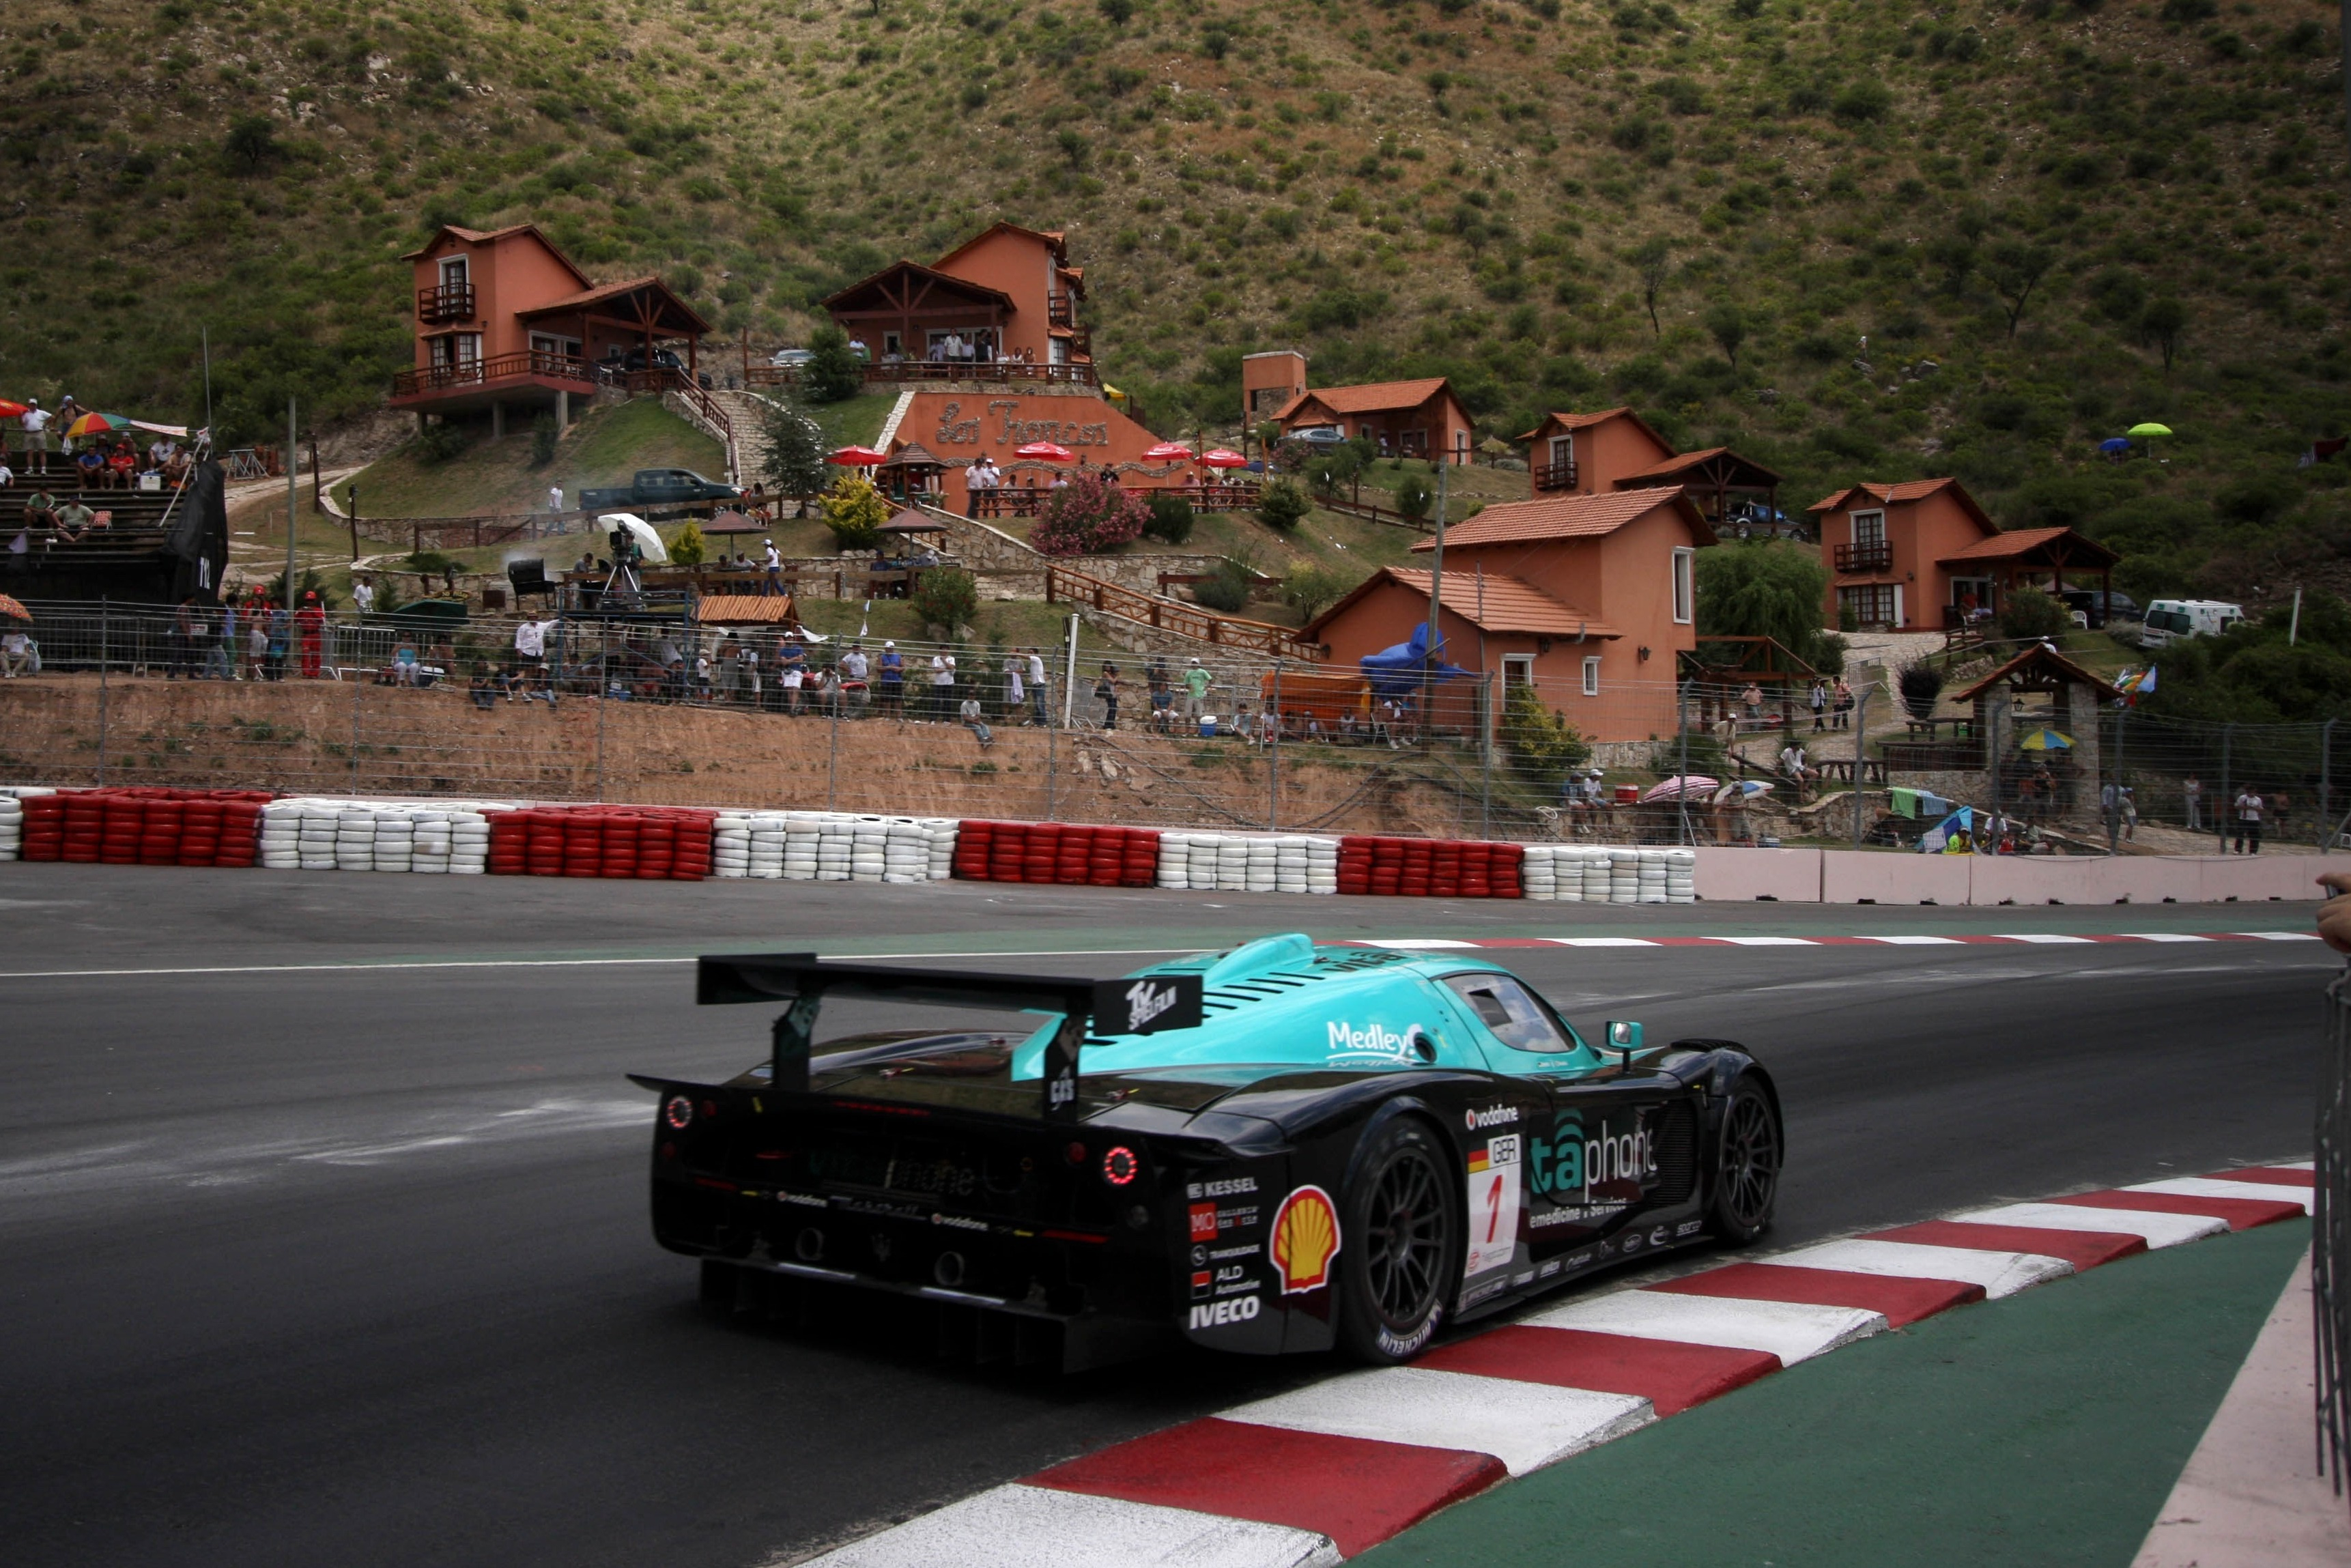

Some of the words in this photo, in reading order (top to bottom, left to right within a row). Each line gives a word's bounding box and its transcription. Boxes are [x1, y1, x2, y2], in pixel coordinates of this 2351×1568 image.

[1327, 1021, 1408, 1061] Medley
[1475, 1103, 1519, 1128] vodafone
[1493, 1138, 1516, 1164] GER
[1204, 1177, 1259, 1197] KESSEL
[1487, 1174, 1502, 1244] 1
[1215, 1265, 1244, 1282] ALD
[1189, 1296, 1260, 1330] IVECO
[1378, 1320, 1431, 1354] MICHELIN
